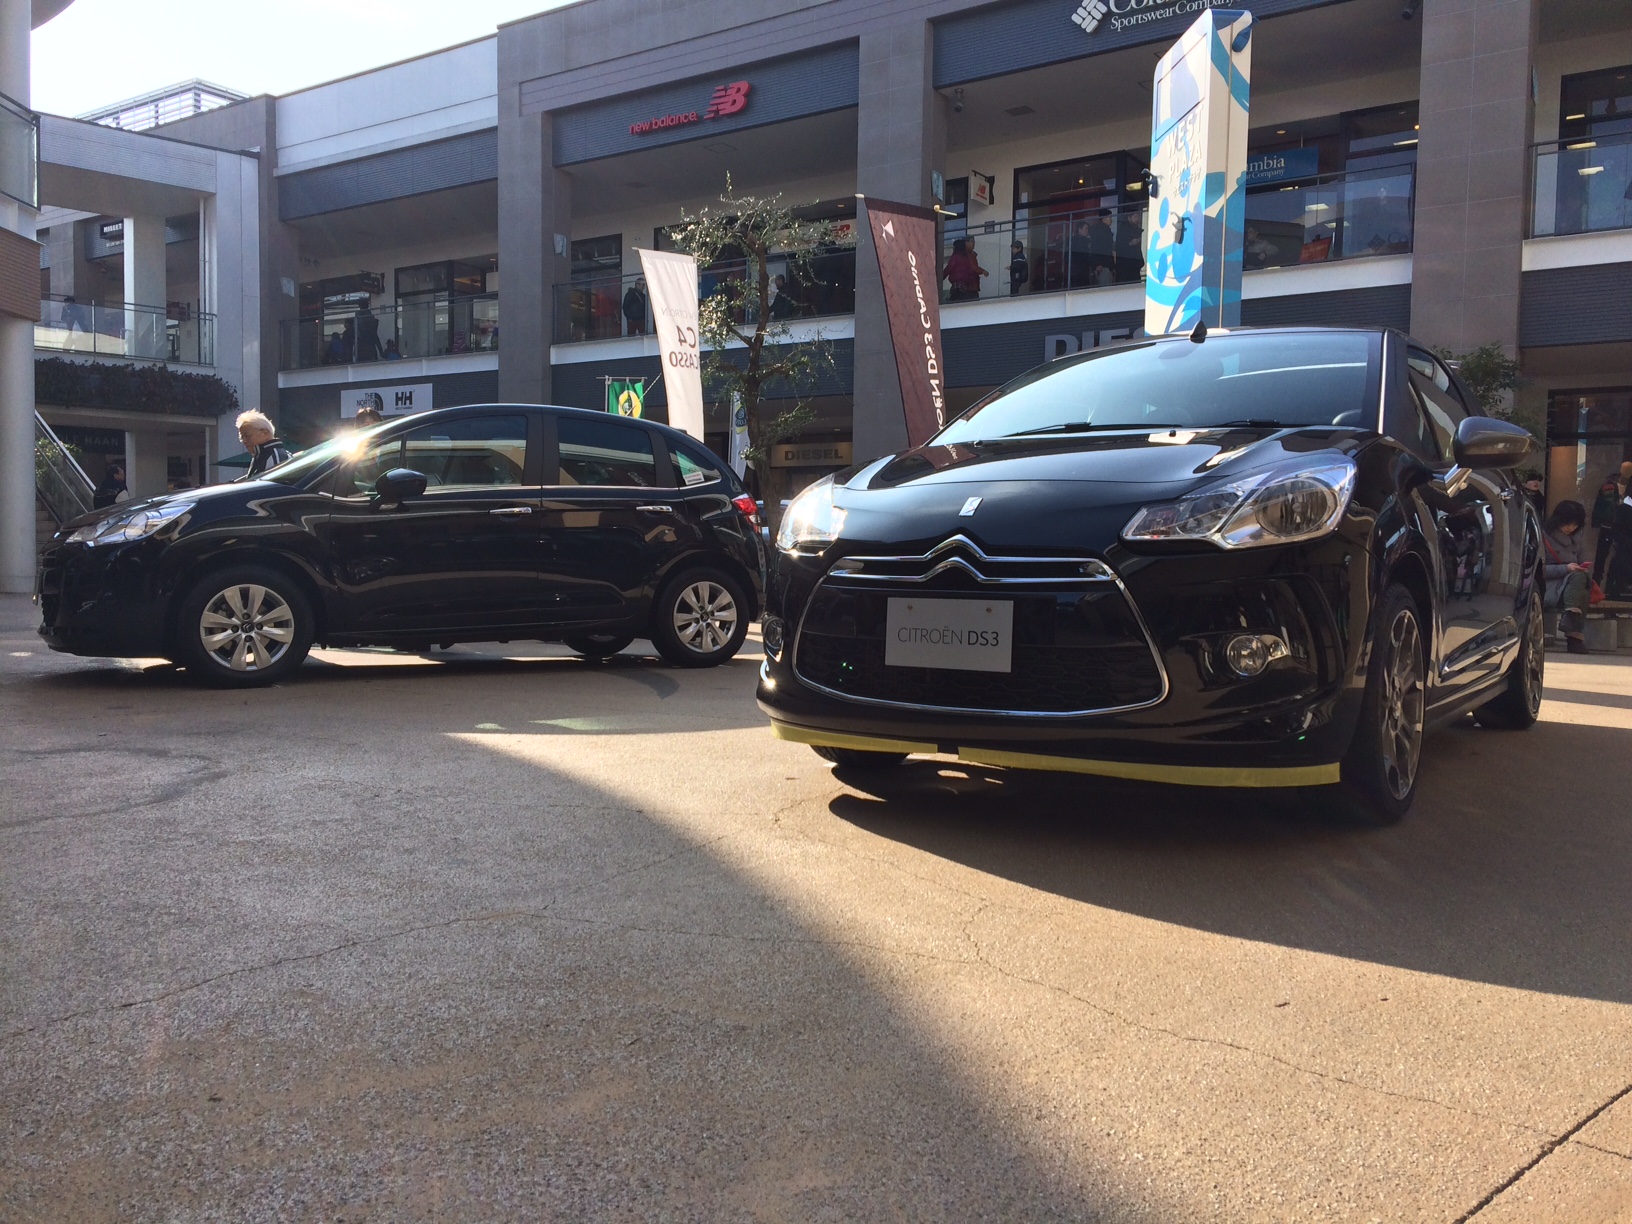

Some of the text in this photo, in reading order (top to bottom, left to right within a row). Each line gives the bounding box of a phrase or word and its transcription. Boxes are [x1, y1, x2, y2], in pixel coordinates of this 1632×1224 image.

[1110, 7, 1176, 32] Sportswear
[629, 111, 698, 135] new balance
[1166, 104, 1204, 159] WEST
[1169, 140, 1203, 184] PLAZA
[1251, 168, 1284, 179] Company
[84, 435, 119, 446] HAAN
[784, 448, 843, 461] DIESEL
[897, 626, 999, 647] CITROËN DS3
